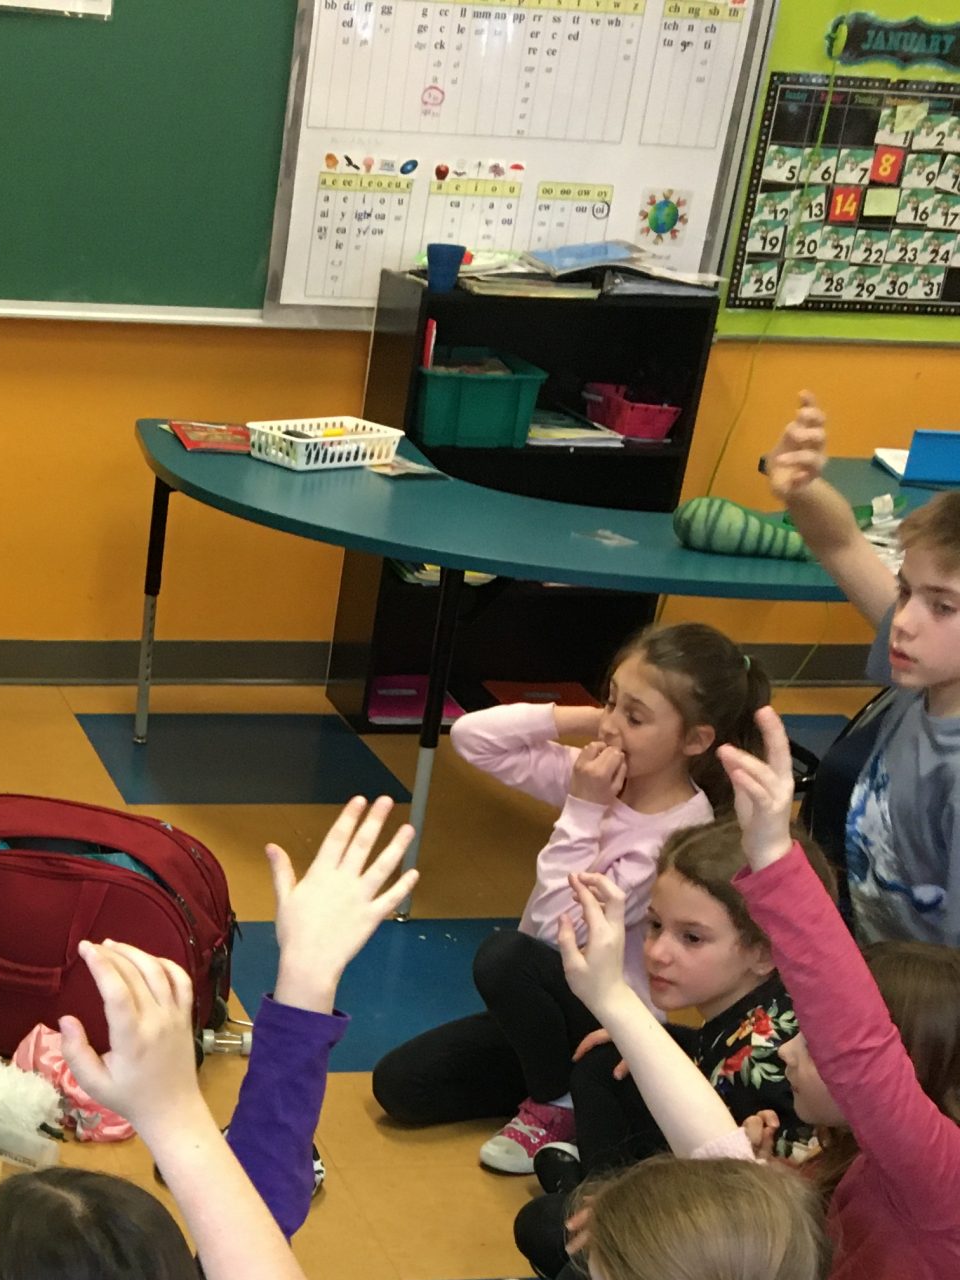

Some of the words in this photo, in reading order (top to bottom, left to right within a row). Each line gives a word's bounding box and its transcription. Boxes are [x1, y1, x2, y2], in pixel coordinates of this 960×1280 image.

[613, 1, 622, 9] w
[380, 5, 393, 15] gg
[421, 8, 429, 17] g
[459, 7, 467, 18] ll
[472, 10, 491, 20] mm
[494, 12, 507, 20] nn
[513, 12, 526, 23] pp
[533, 13, 543, 22] rr
[552, 15, 562, 24] ss
[572, 14, 580, 25] tt
[590, 17, 601, 26] ve
[607, 16, 622, 27] wh
[688, 7, 701, 19] ng
[709, 6, 720, 16] sh
[342, 18, 354, 28] ed
[417, 24, 429, 34] ge
[456, 24, 466, 35] le
[530, 30, 541, 39] er
[551, 31, 557, 40] c
[567, 30, 580, 41] ed
[663, 20, 679, 31] tch
[704, 24, 717, 34] ch
[434, 40, 446, 50] ck
[527, 46, 538, 55] re
[546, 48, 558, 57] ce
[861, 30, 956, 55] JANUARY
[935, 131, 946, 146] 2
[785, 166, 797, 181] 5
[820, 165, 832, 181] 6
[858, 167, 869, 182] 7
[878, 153, 896, 177] 8
[925, 171, 936, 186] 9
[491, 185, 498, 193] o
[542, 187, 553, 195] oo
[577, 189, 591, 197] ow
[323, 195, 330, 203] a
[342, 195, 349, 204] e
[379, 197, 386, 206] o
[397, 198, 404, 206] u
[449, 200, 461, 208] ea
[488, 201, 495, 210] a
[320, 208, 329, 218] ai
[339, 211, 346, 221] y
[374, 212, 386, 220] oa
[538, 203, 551, 212] ew
[575, 205, 588, 213] ou
[595, 205, 605, 215] oi
[772, 207, 789, 221] 12
[806, 202, 824, 218] 13
[834, 194, 858, 217] 14
[912, 206, 930, 222] 16
[941, 209, 959, 227] 17
[501, 217, 513, 225] ou
[336, 226, 347, 234] ea
[371, 227, 384, 235] ow
[760, 236, 779, 251] 19
[795, 239, 818, 255] 20
[833, 244, 851, 259] 21
[862, 248, 883, 263] 22
[897, 246, 918, 263] 23
[929, 248, 950, 264] 24
[753, 278, 775, 293] 26
[824, 277, 845, 293] 28
[855, 283, 876, 298] 29
[886, 281, 908, 296] 30
[924, 281, 940, 296] 31
